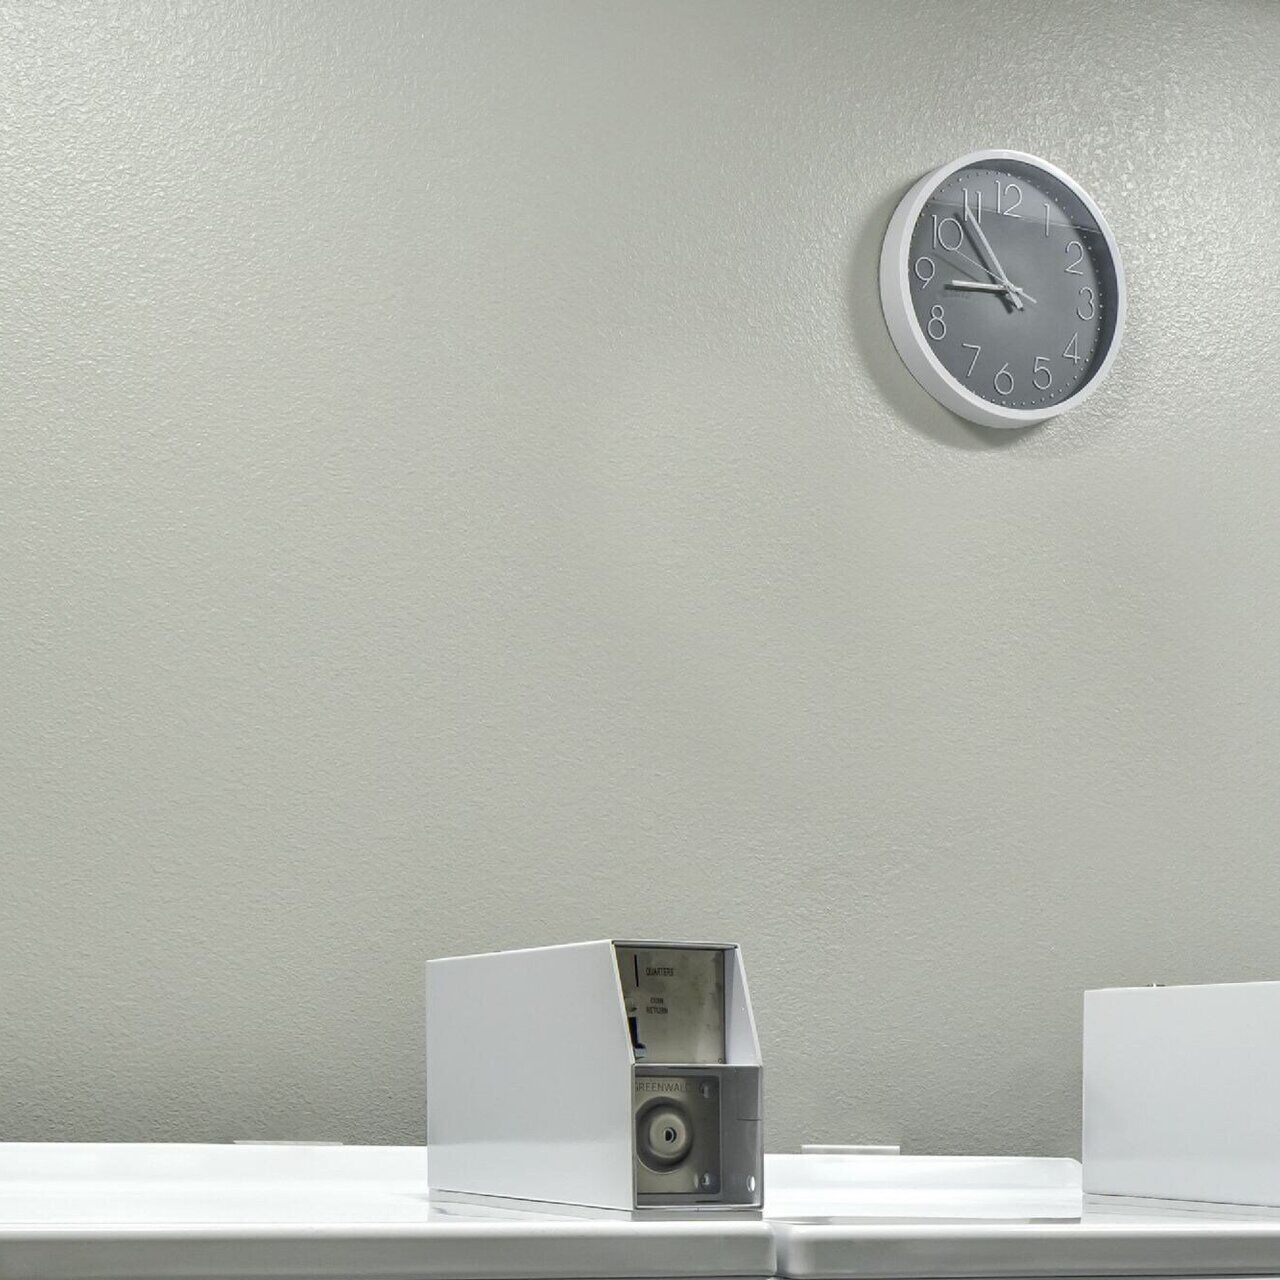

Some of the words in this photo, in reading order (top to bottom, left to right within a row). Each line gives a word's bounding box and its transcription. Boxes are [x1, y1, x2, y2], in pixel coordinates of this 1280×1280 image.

[963, 188, 982, 224] 11
[995, 180, 1023, 218] 12
[932, 214, 963, 251] 10
[1044, 203, 1051, 237] 1
[915, 256, 936, 289] 9
[1065, 241, 1084, 275] 2
[1077, 287, 1095, 321] 3
[927, 305, 947, 340] 8
[962, 343, 982, 377] 7
[1063, 333, 1081, 364] 4
[994, 363, 1014, 395] 6
[1033, 356, 1053, 390] 5
[645, 967, 674, 977] QUARTERS
